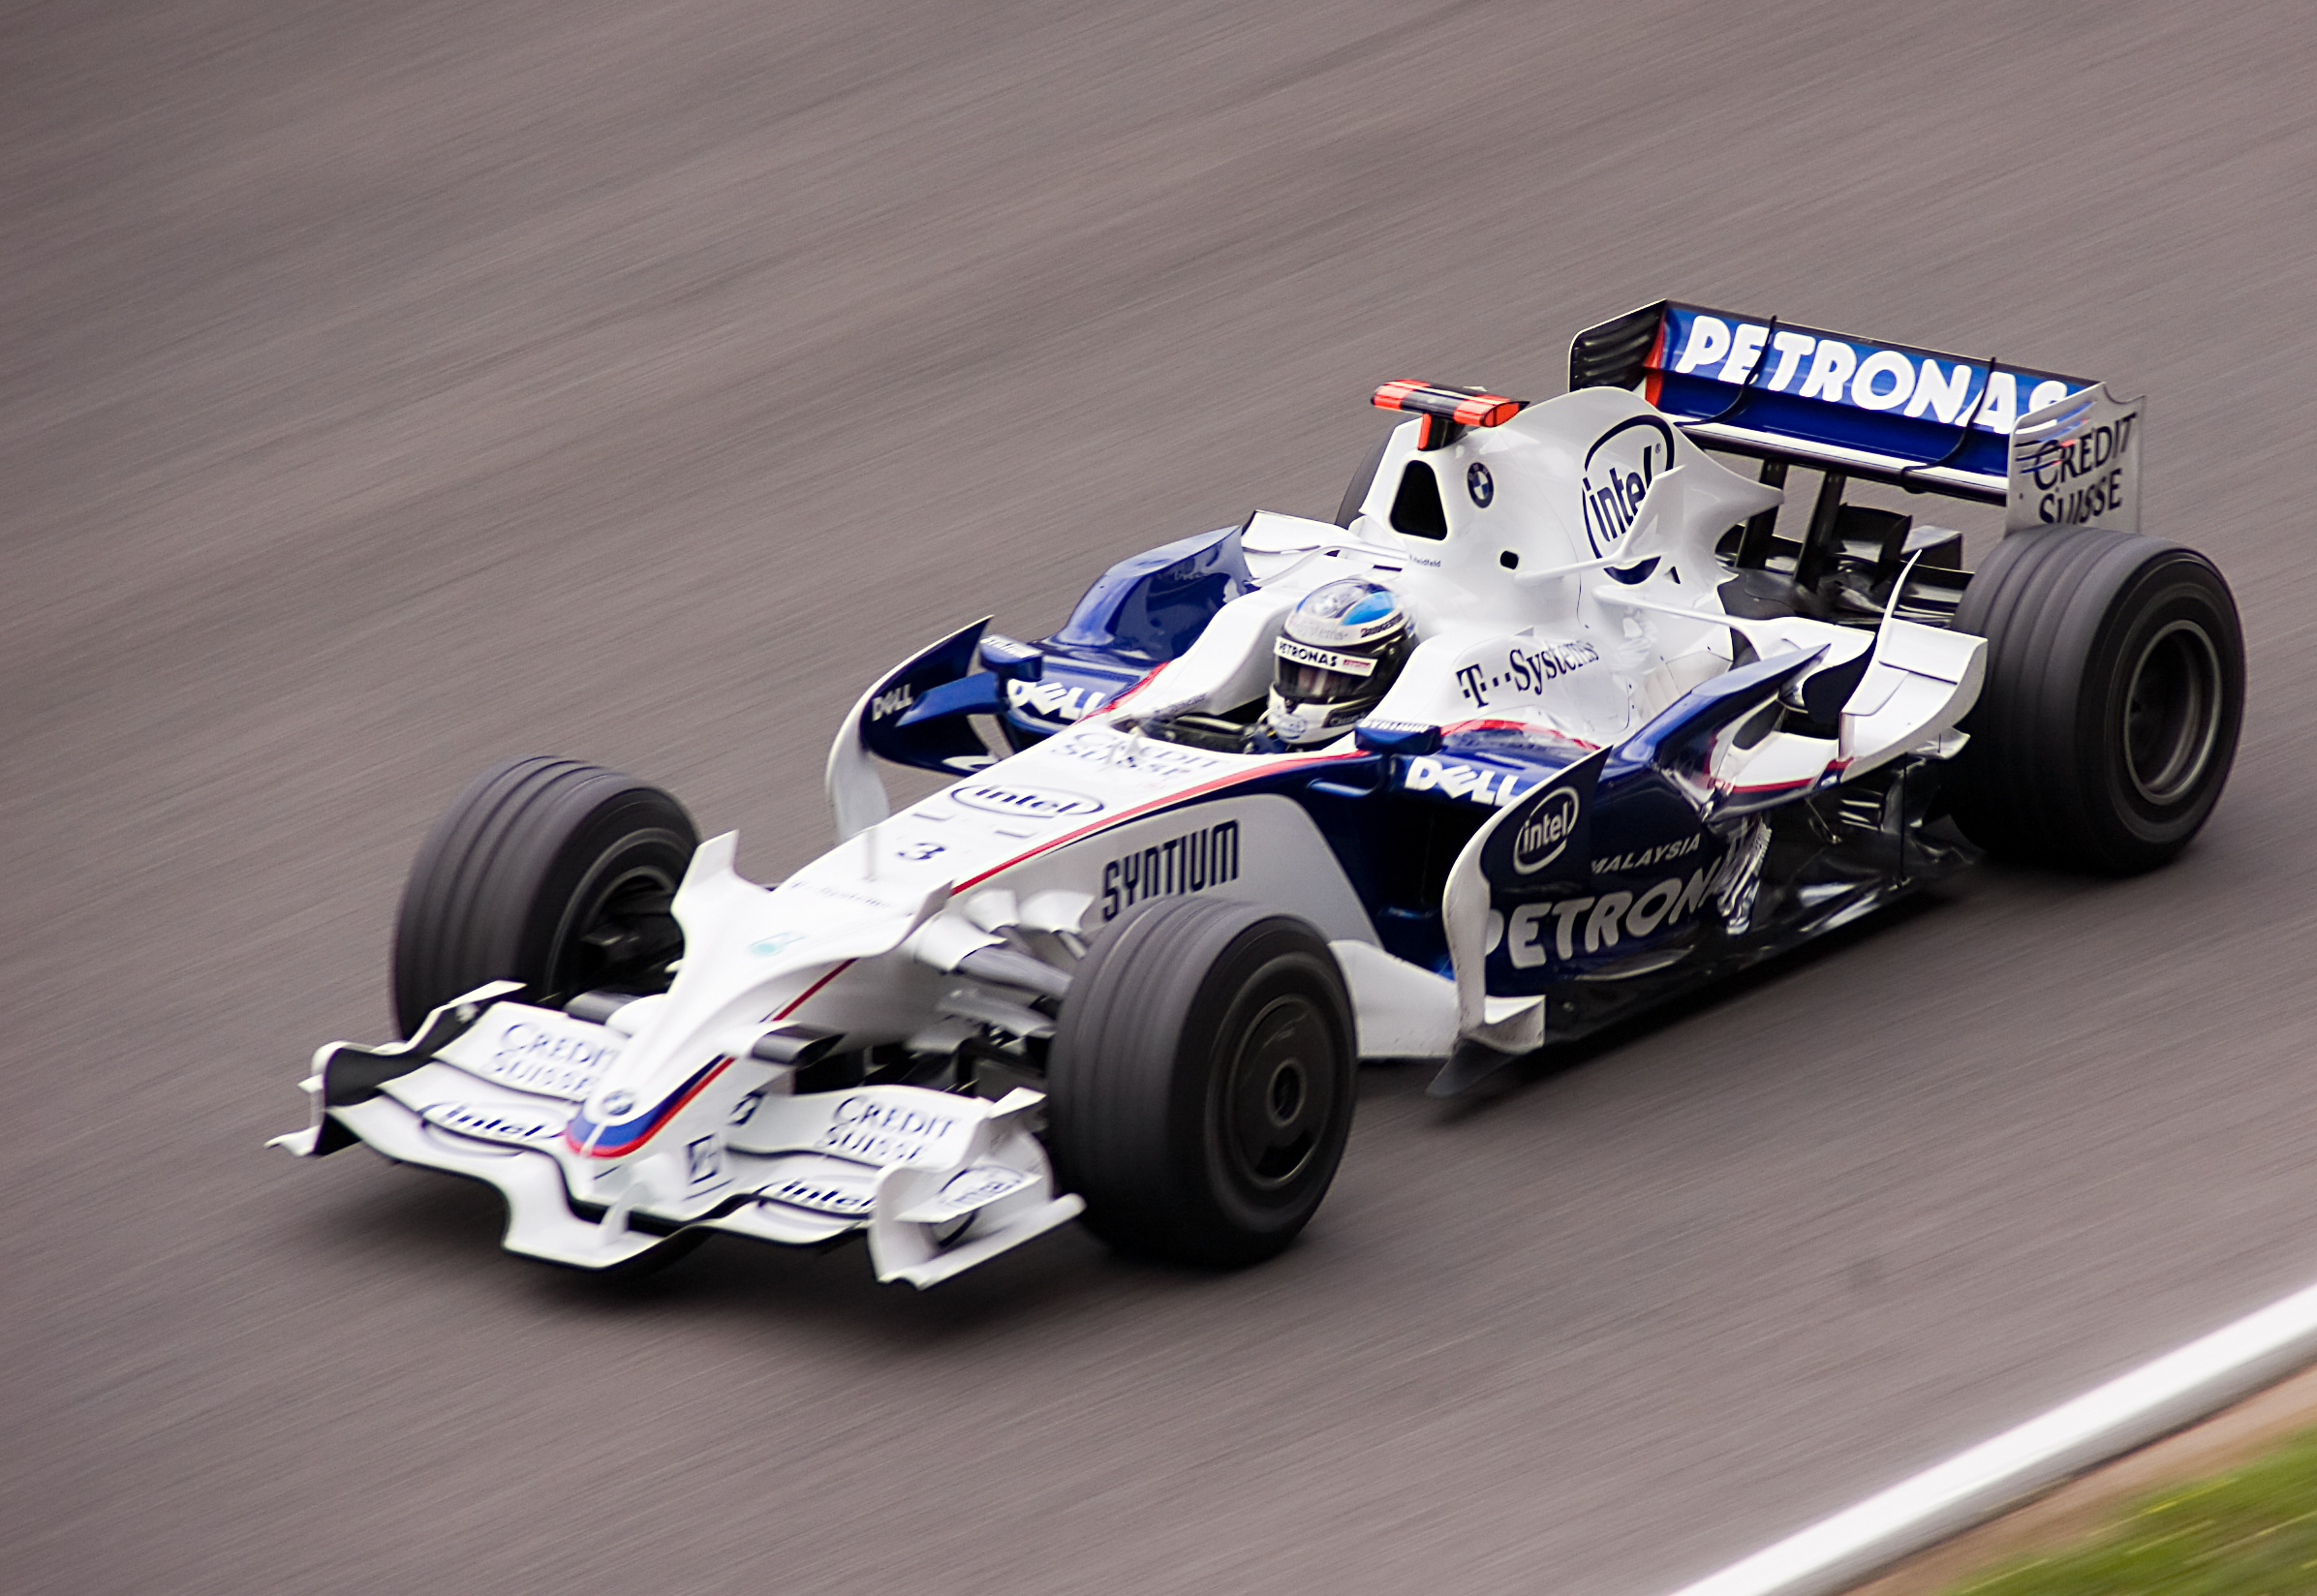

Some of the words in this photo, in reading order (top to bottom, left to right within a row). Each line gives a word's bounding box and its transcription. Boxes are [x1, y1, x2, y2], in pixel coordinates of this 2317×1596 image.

[2033, 412, 2138, 490] CREDIT
[2038, 468, 2122, 524] SUISSE
[1279, 640, 1339, 667] PETRONAS
[872, 684, 912, 721] DELL
[1006, 678, 1106, 720] DELL
[974, 785, 1080, 814] intel
[1405, 756, 1523, 807] DELL
[1520, 801, 1571, 855] intel
[897, 842, 946, 861] 3
[1101, 819, 1240, 922] SYNTIUM
[1591, 833, 1701, 875] MALAYSIA
[502, 1023, 618, 1065] CREDIT
[446, 1105, 552, 1138] intel
[832, 1094, 956, 1139] CREDIT
[817, 1122, 928, 1161] SUISSE
